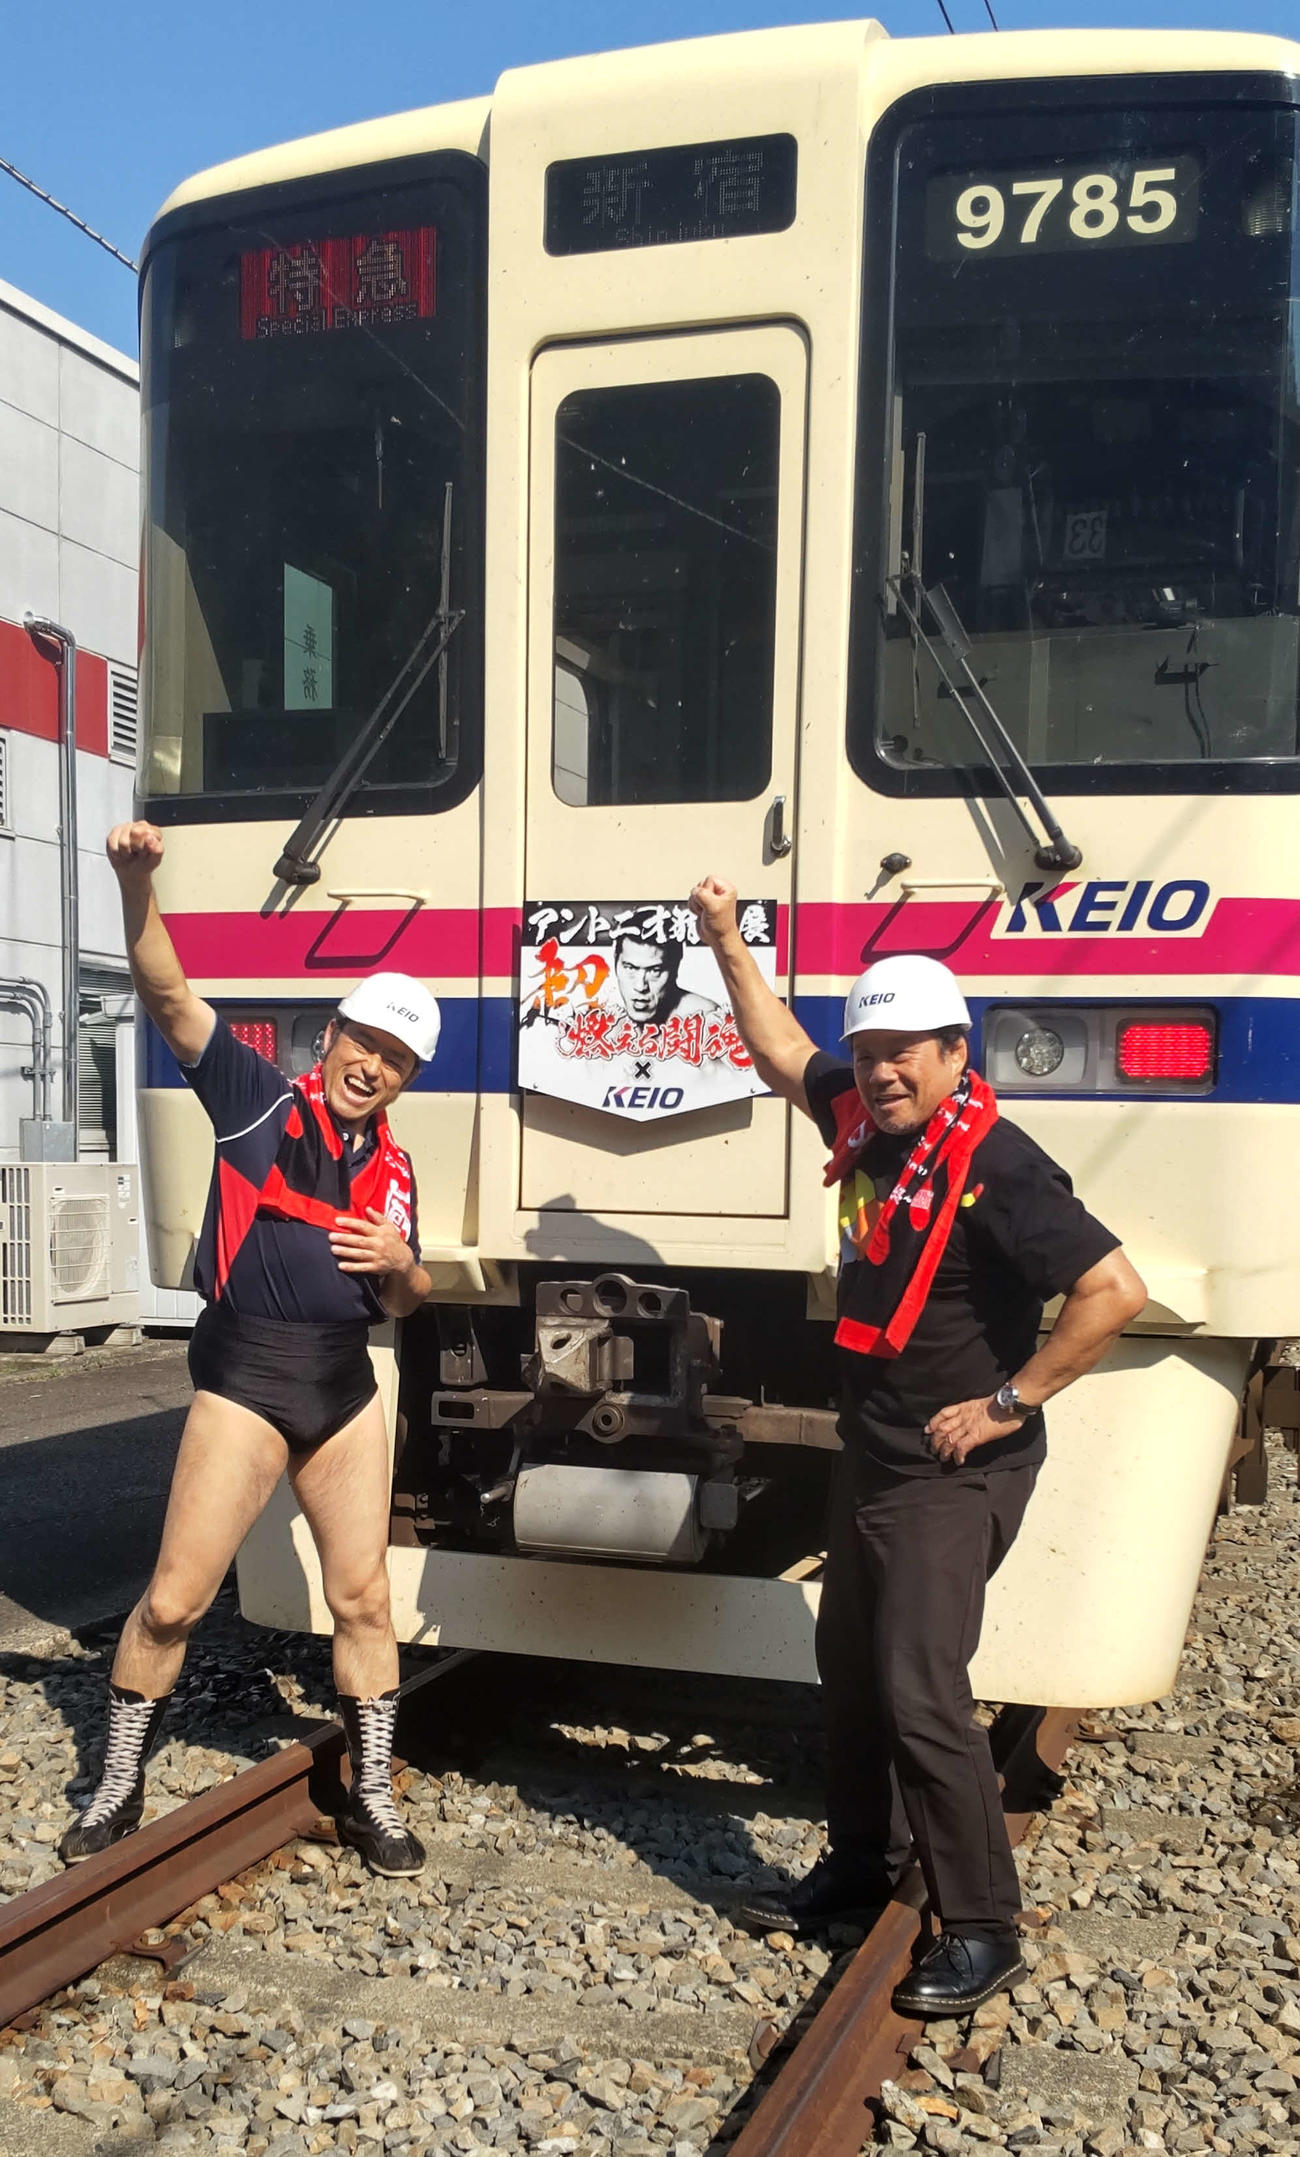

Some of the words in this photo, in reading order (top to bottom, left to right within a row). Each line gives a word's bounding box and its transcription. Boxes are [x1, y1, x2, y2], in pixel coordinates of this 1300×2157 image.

[955, 167, 1178, 250] 9785
[269, 239, 408, 314] 特急
[256, 308, 327, 339] Special
[334, 303, 418, 329] Express
[528, 904, 771, 945] アントニオ猪展
[1005, 879, 1211, 933] KEIO
[858, 992, 896, 1009] KEIO
[602, 1085, 685, 1110] KEIO
